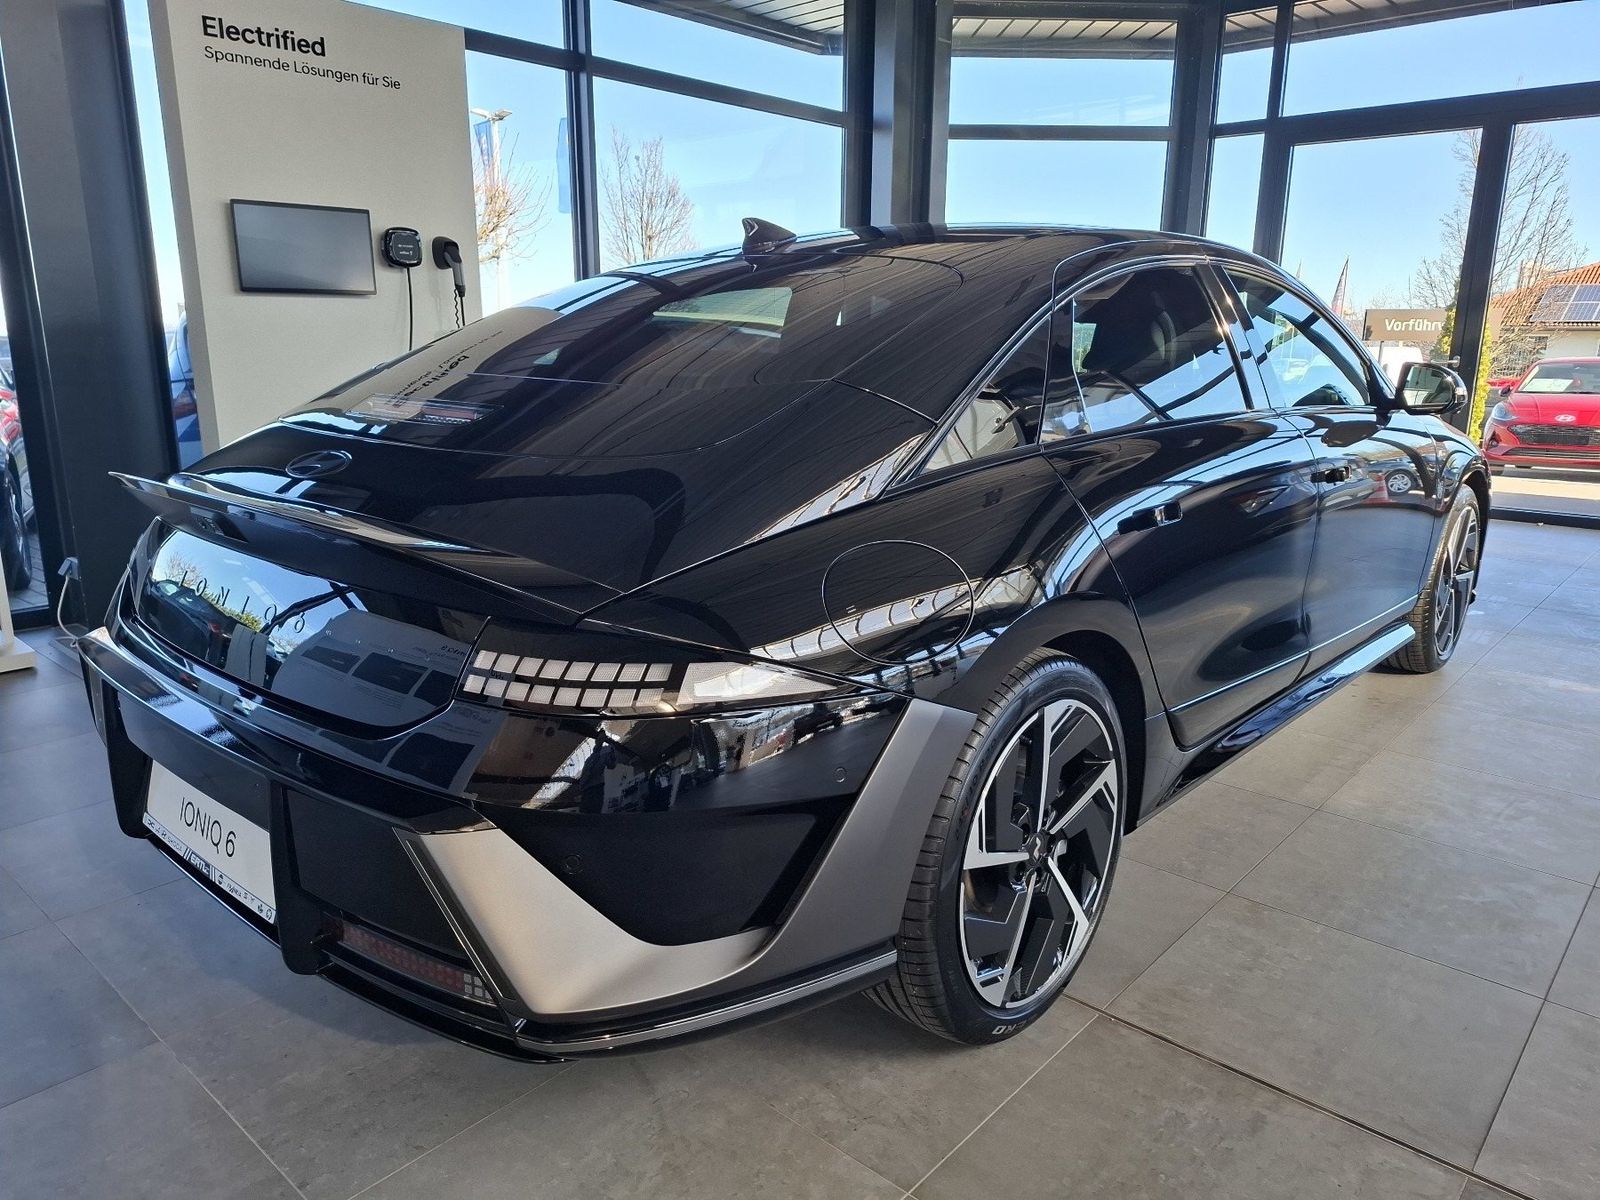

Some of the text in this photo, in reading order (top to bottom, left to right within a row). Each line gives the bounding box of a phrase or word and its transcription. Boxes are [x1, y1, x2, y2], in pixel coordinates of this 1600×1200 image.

[201, 15, 326, 57] Electrified
[204, 45, 401, 90] Spannende Lösungen für Sie
[180, 797, 222, 854] IONIQ
[225, 830, 237, 858] 6
